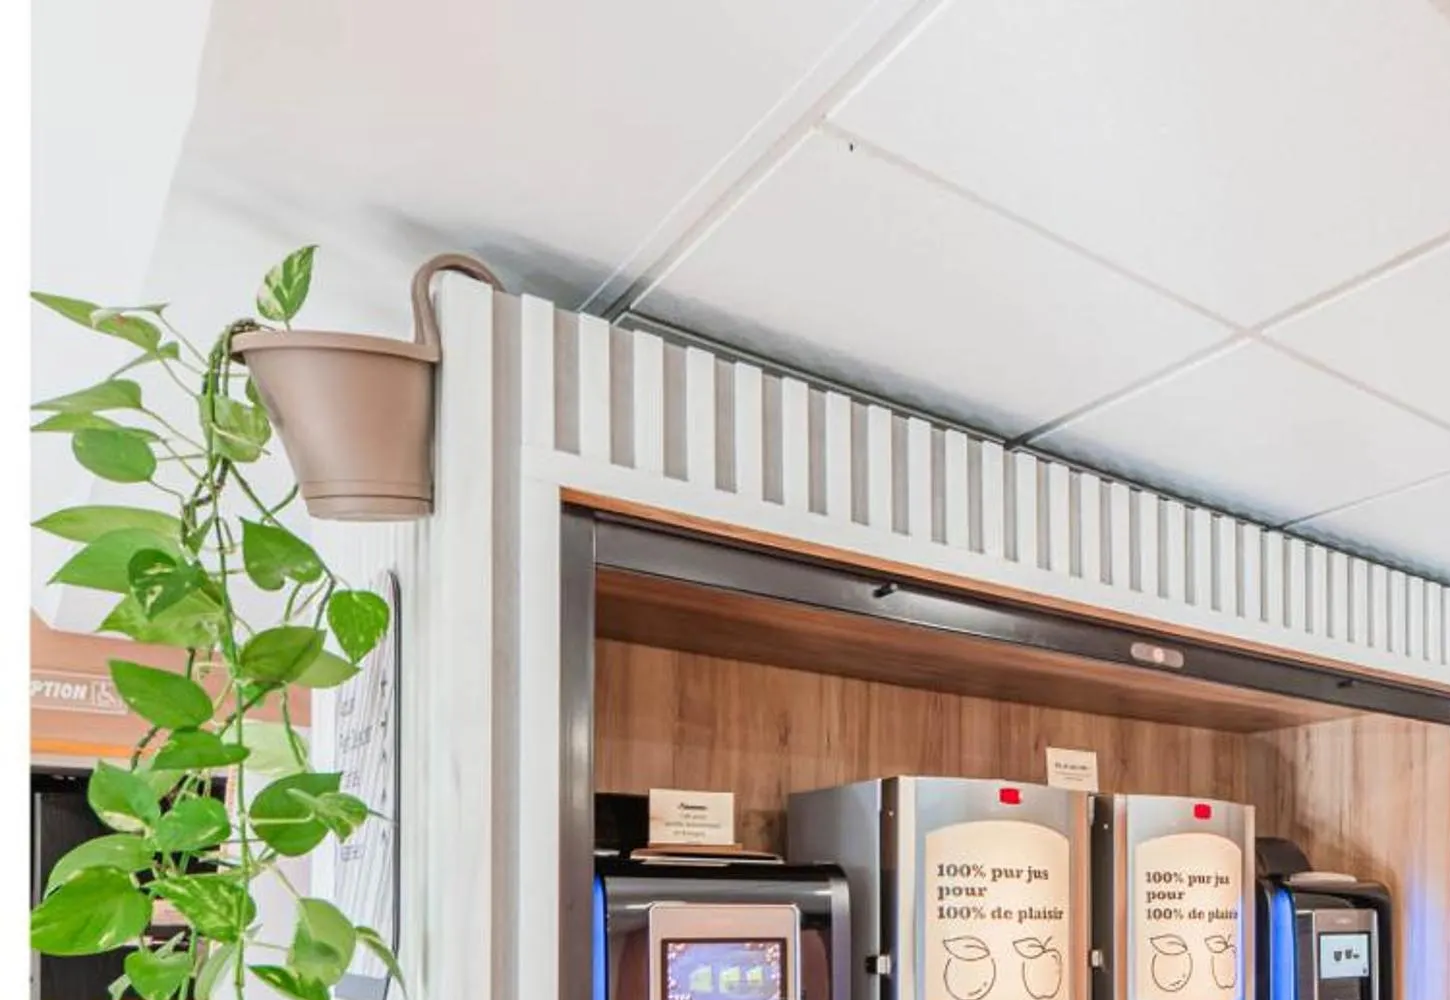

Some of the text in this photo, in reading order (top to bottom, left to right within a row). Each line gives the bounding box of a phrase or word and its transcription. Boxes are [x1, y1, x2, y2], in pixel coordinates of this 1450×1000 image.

[937, 863, 1049, 883] 100% pur jus
[1145, 871, 1230, 888] 100% pur jus
[937, 885, 988, 900] pour
[1146, 890, 1186, 903] pour
[937, 905, 1064, 924] 100% de plaisir
[1145, 907, 1184, 920] 100%
[1188, 907, 1205, 920] de
